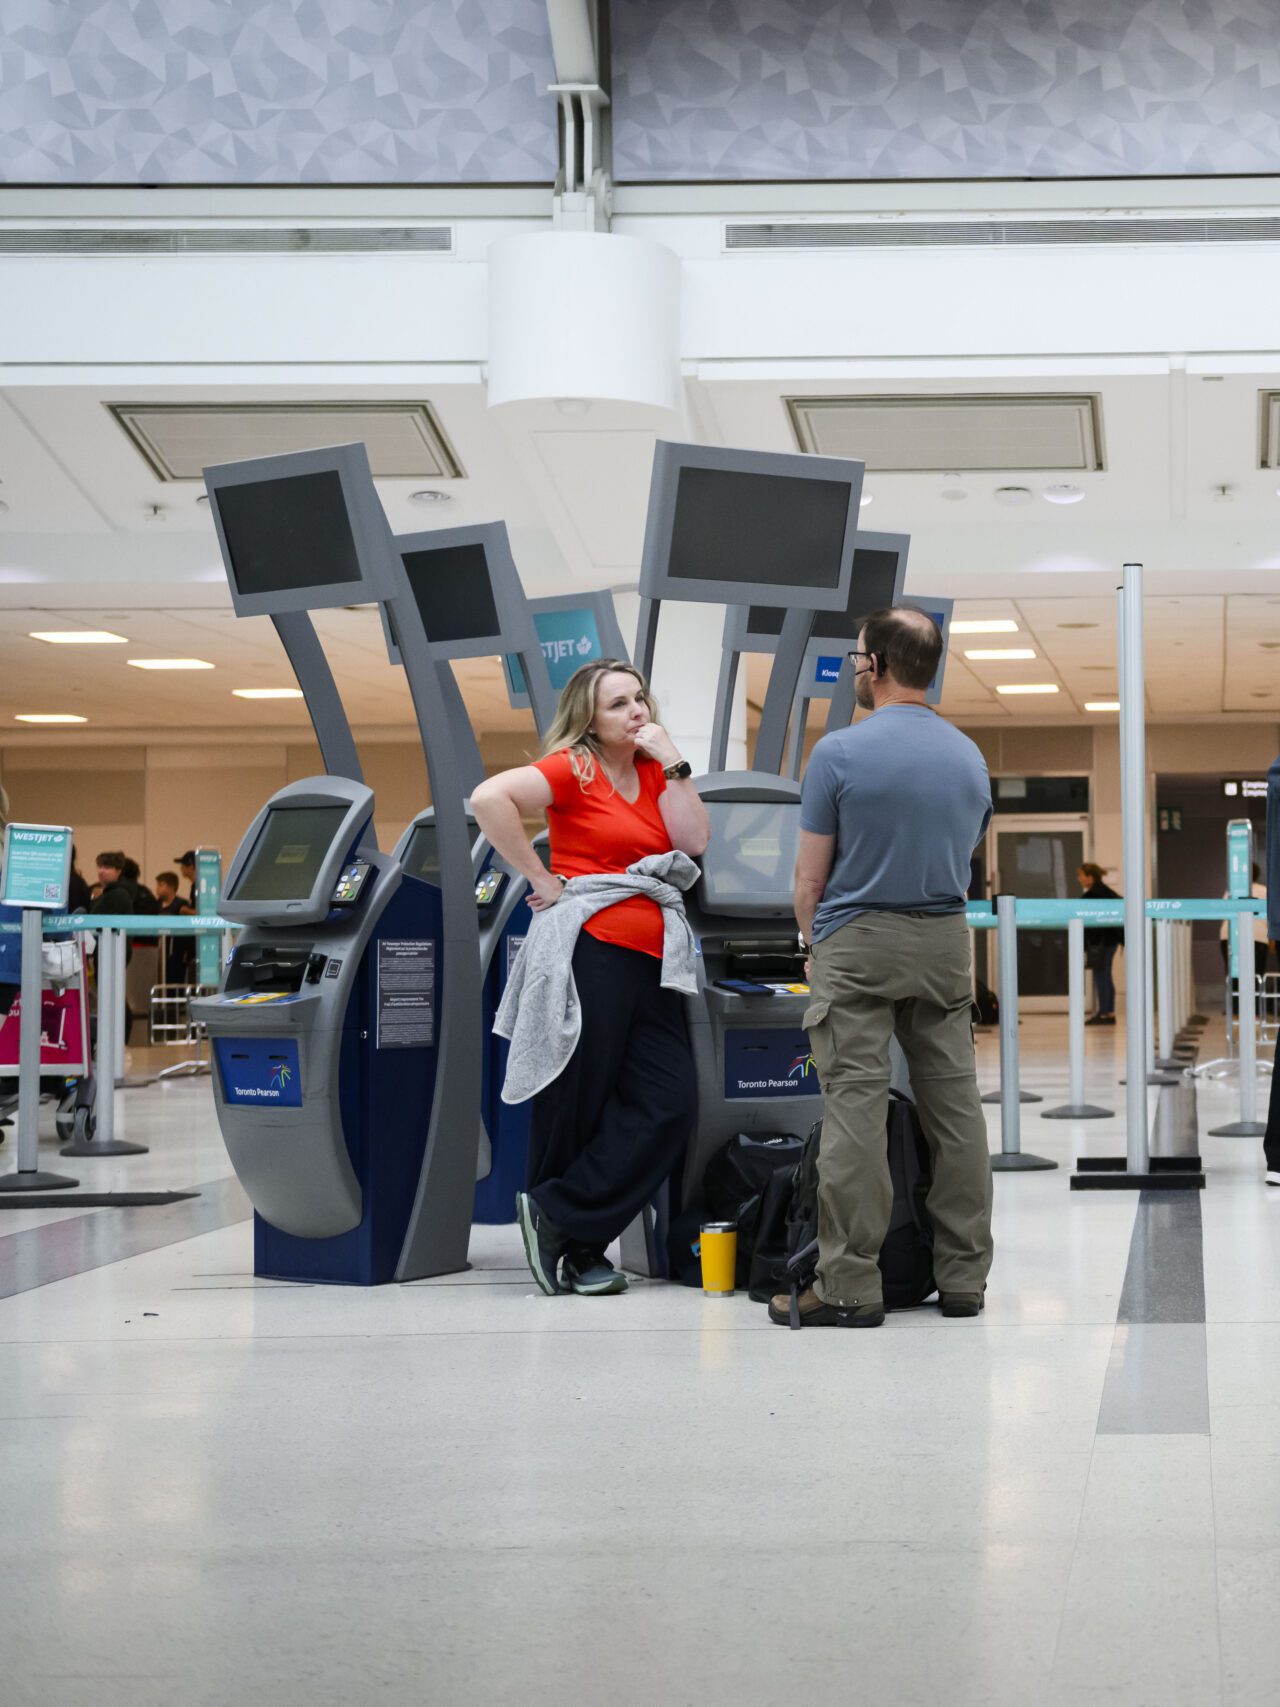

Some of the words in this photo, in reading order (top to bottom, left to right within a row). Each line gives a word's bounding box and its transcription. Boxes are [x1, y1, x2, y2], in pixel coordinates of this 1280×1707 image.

[540, 639, 575, 664] STJET
[822, 669, 839, 679] Kiosq
[13, 832, 54, 843] WESTJET
[1146, 901, 1170, 911] STJET
[737, 1080, 767, 1089] Toronto
[768, 1079, 798, 1088] Pearson
[234, 1087, 257, 1096] Toronto
[257, 1088, 280, 1097] Pearson
